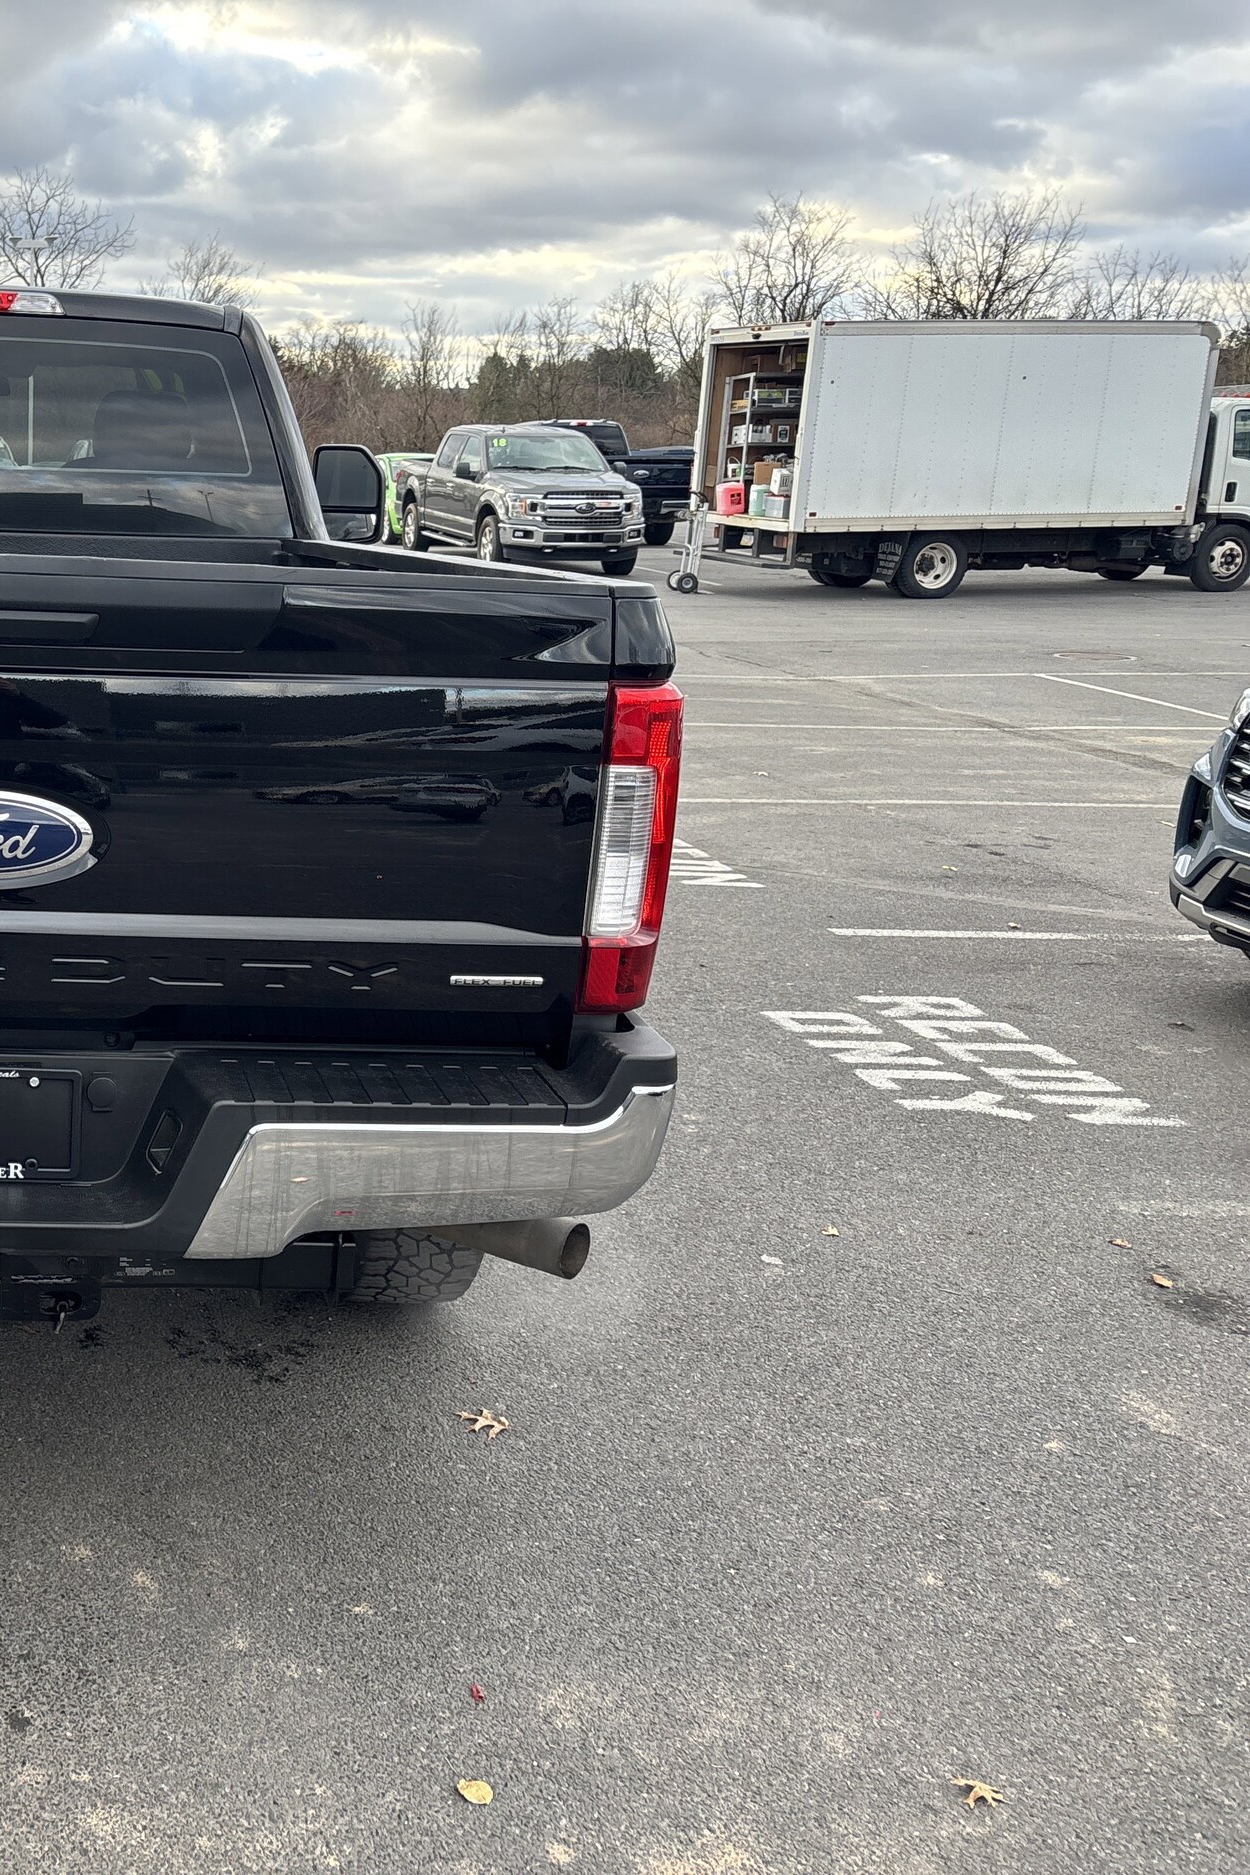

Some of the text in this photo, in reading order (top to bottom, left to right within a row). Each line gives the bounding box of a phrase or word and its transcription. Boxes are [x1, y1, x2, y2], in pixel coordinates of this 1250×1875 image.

[492, 437, 507, 447] 18
[50, 954, 399, 991] DUTY
[454, 977, 542, 987] FLEX FUEL
[760, 1009, 1037, 1124] ONLY
[856, 994, 1192, 1128] RECON
